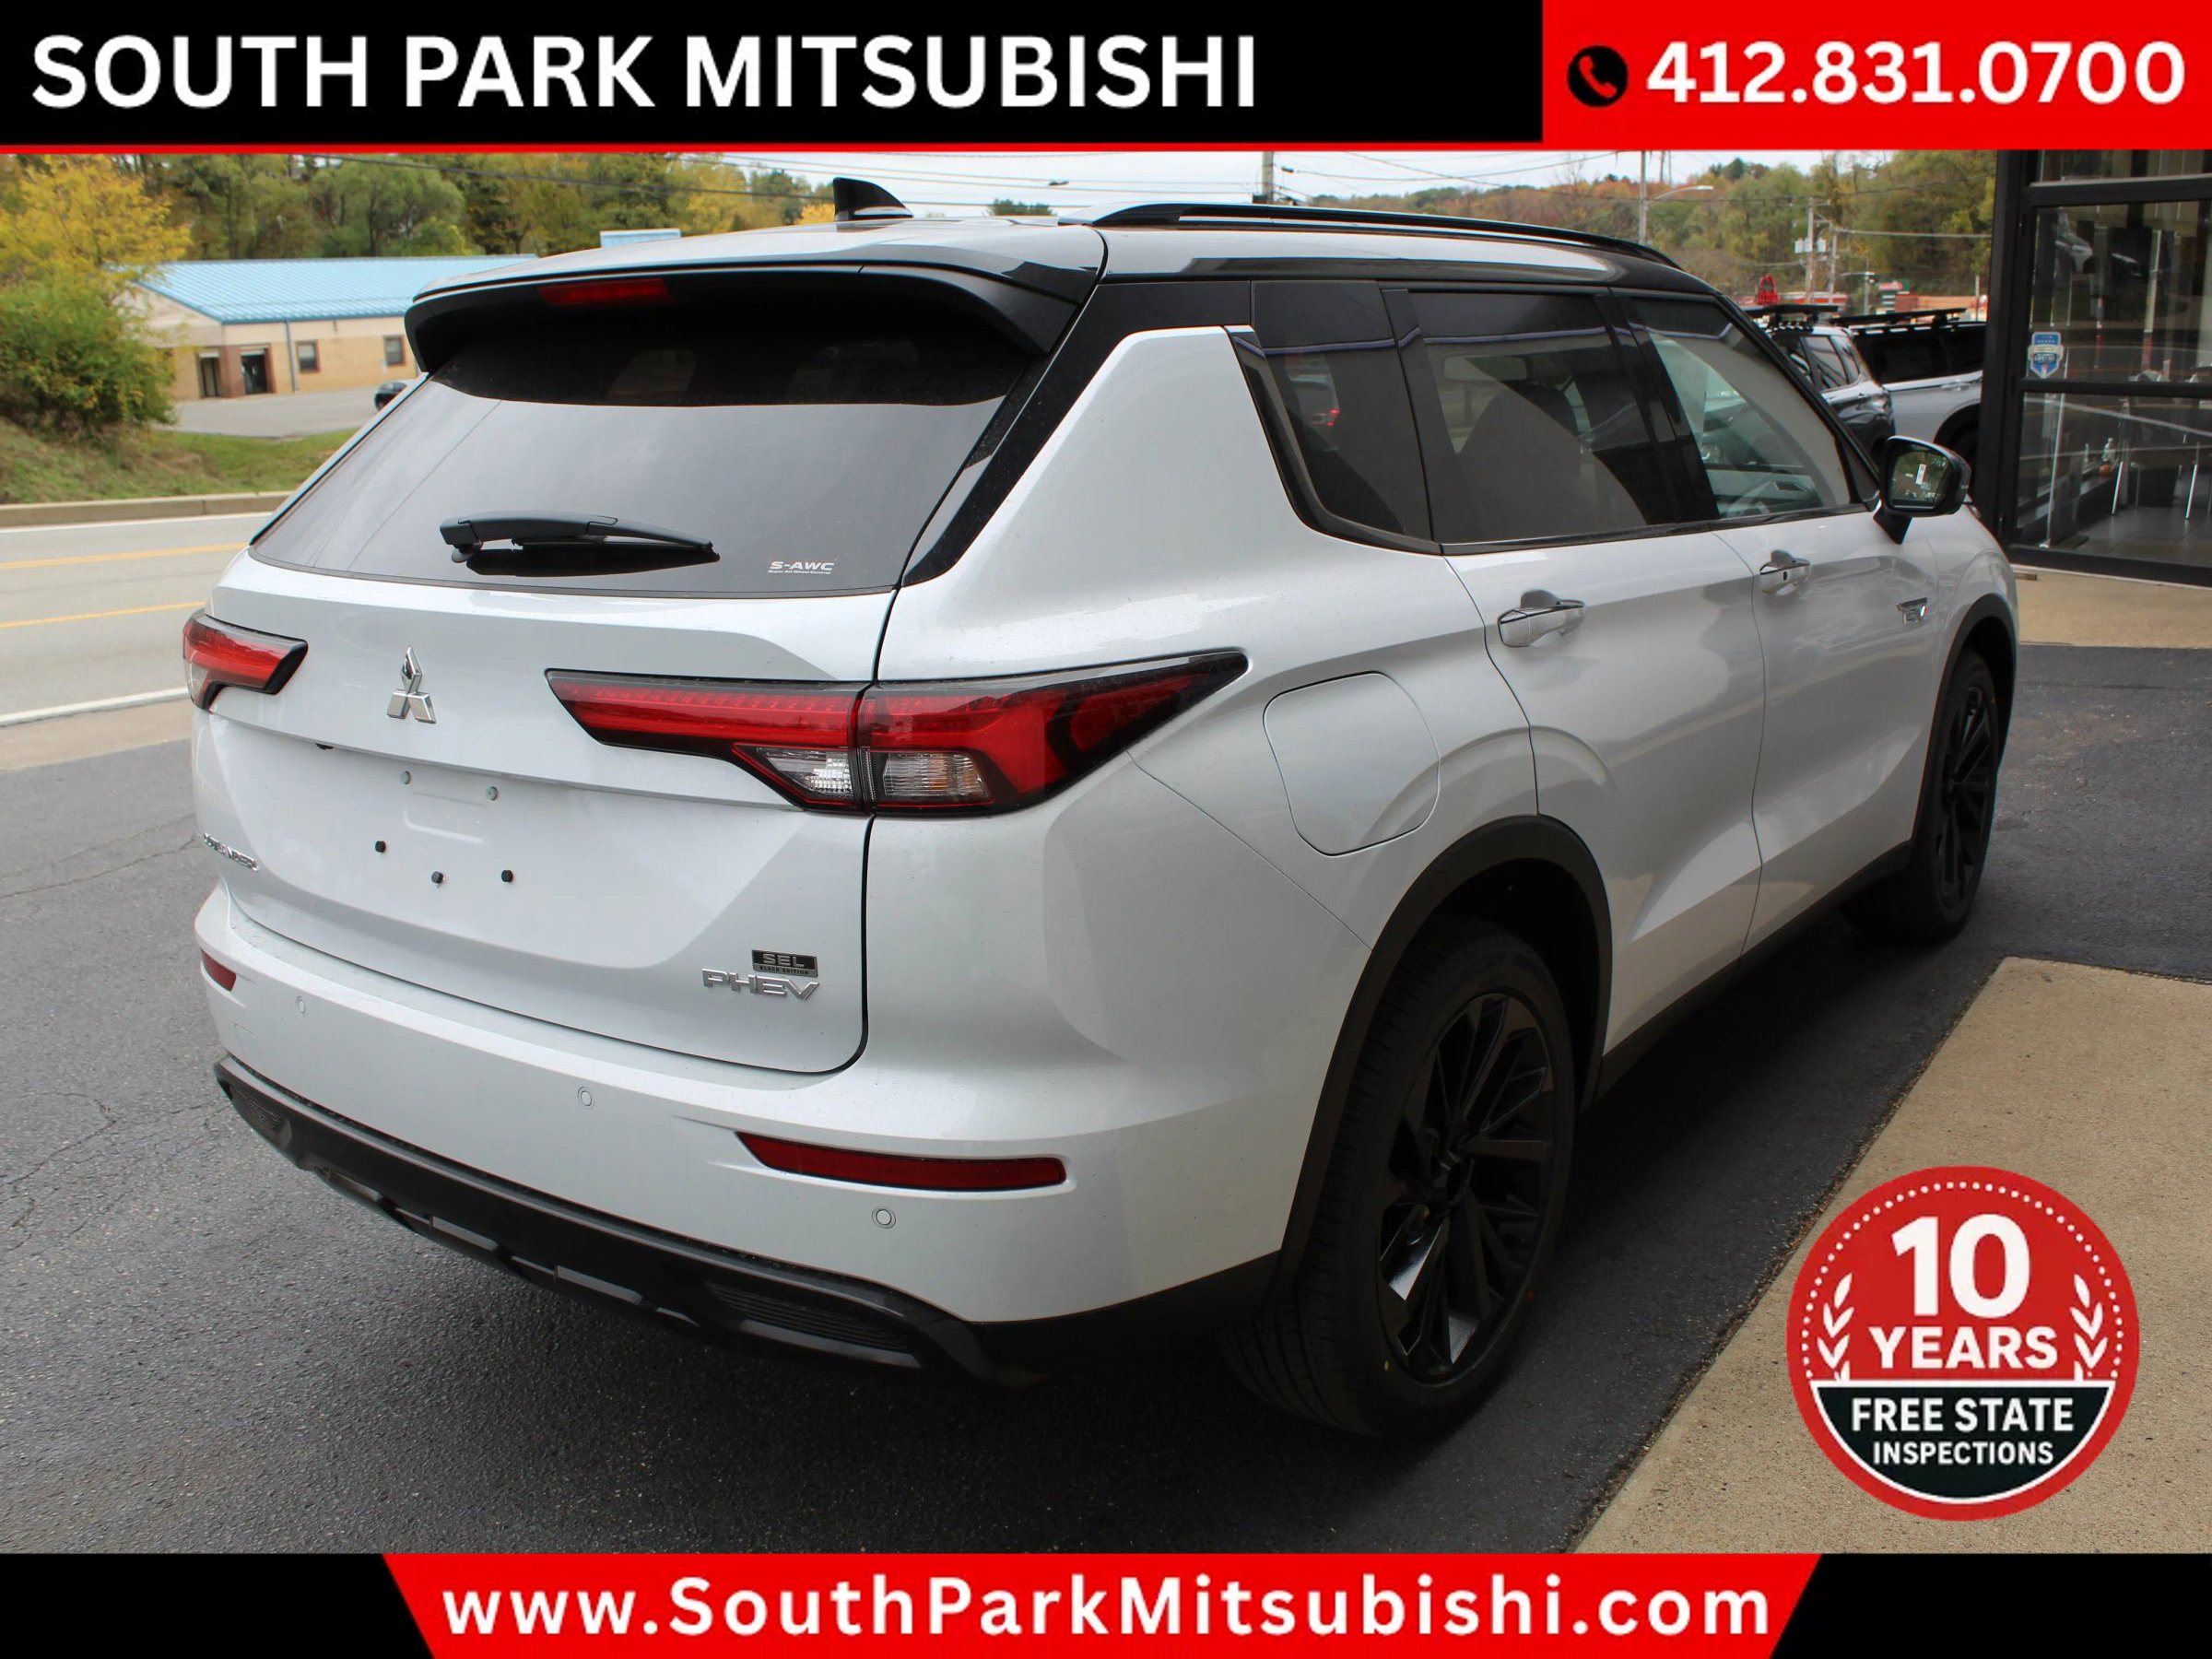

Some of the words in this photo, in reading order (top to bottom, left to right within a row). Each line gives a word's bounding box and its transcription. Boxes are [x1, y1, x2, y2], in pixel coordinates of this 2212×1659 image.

[769, 560, 835, 571] S-AWC
[762, 953, 805, 968] SEL
[701, 968, 819, 1000] PHEV
